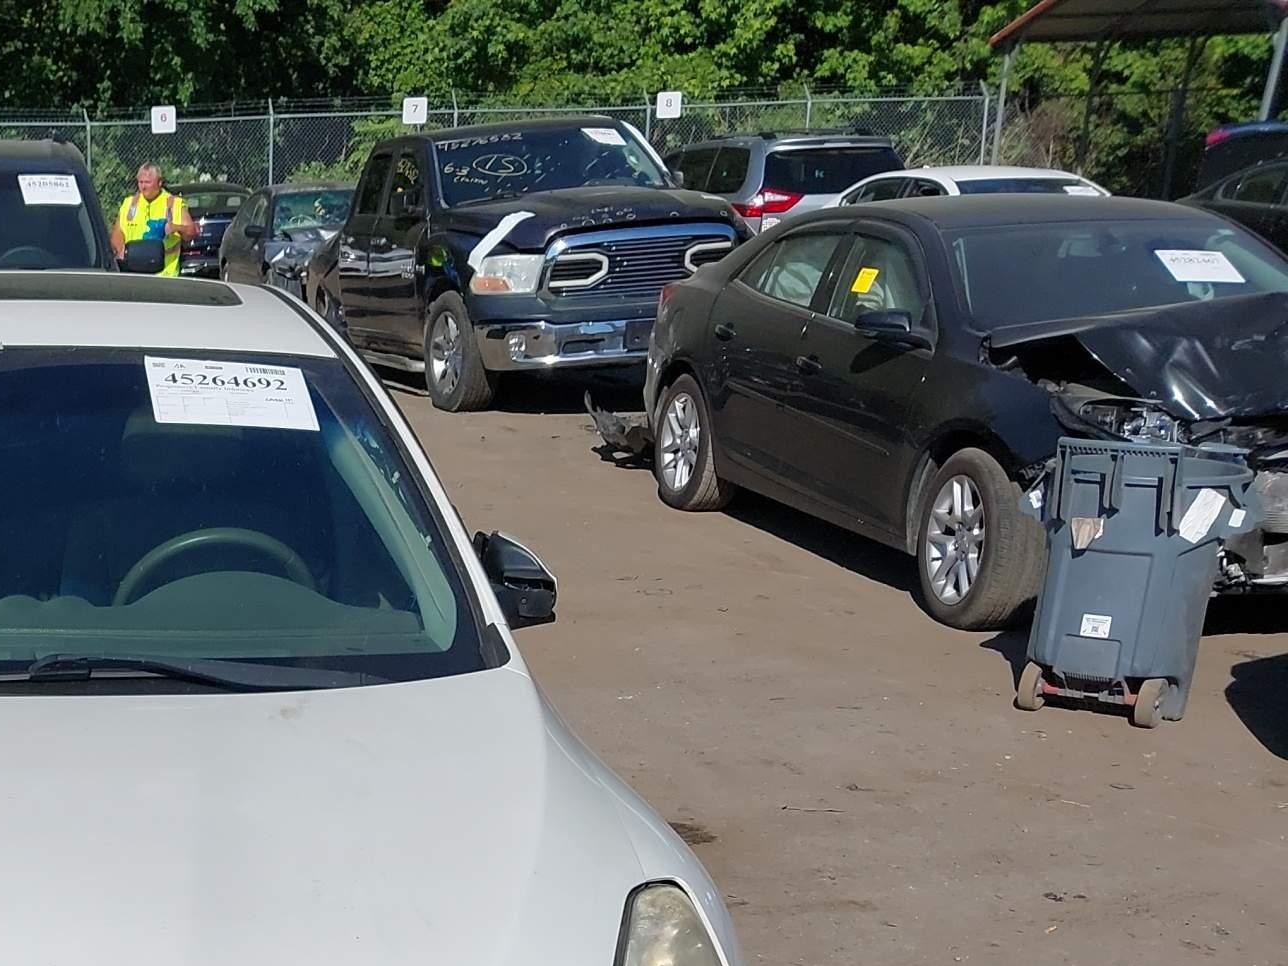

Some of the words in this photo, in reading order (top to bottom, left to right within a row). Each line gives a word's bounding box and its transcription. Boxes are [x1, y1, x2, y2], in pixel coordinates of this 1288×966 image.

[665, 98, 673, 107] 8
[412, 104, 418, 113] 7
[160, 113, 168, 122] 6
[164, 372, 288, 391] 45264692
